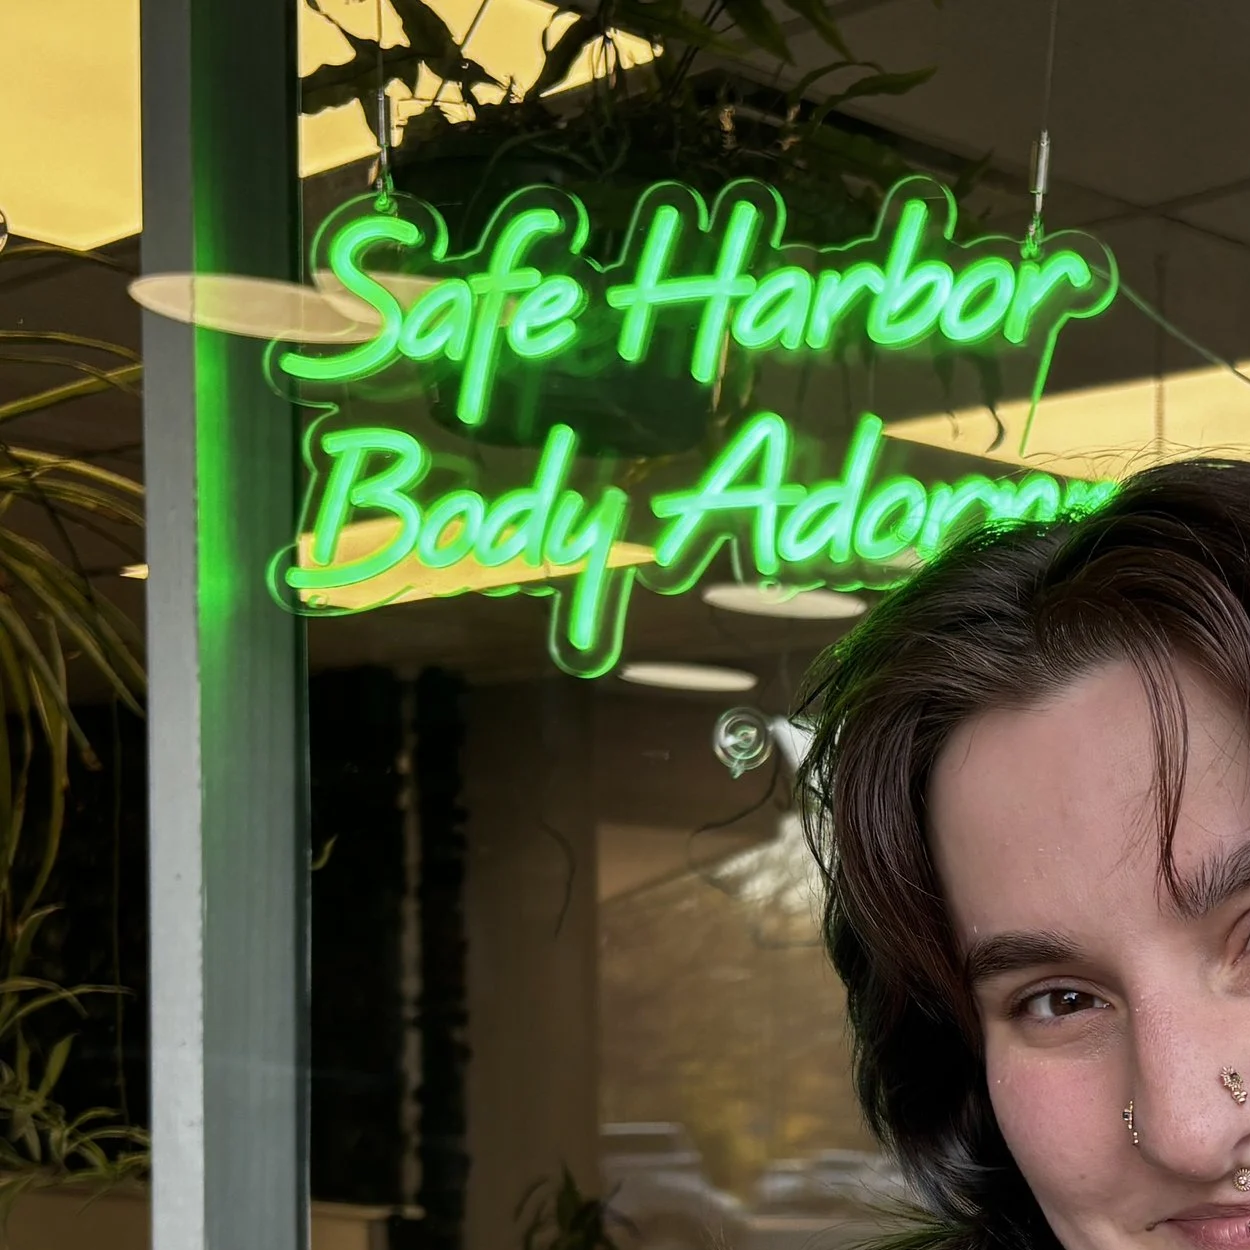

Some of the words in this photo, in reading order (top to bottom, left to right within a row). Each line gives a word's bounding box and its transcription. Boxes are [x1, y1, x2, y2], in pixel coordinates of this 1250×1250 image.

[281, 206, 586, 426] Safe
[607, 199, 1092, 384] Harbor
[284, 423, 629, 651] Body
